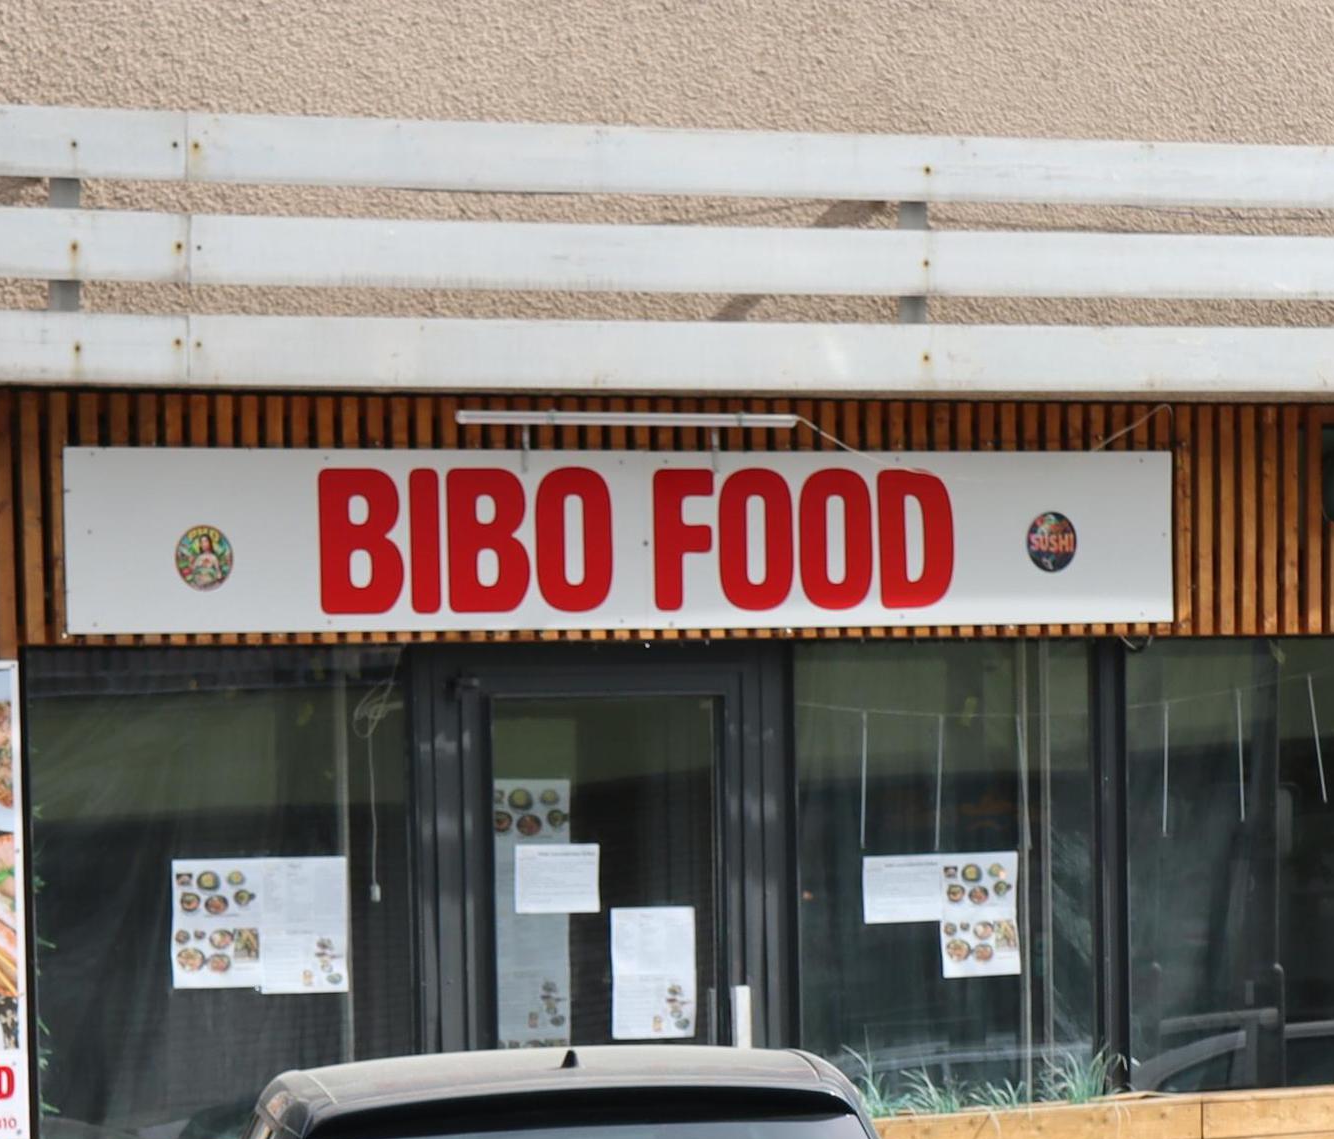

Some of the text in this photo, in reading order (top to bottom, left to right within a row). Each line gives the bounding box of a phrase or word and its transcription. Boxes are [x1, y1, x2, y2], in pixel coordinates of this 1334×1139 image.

[318, 466, 955, 615] BIBO FOOD
[1029, 532, 1075, 553] SUSHI
